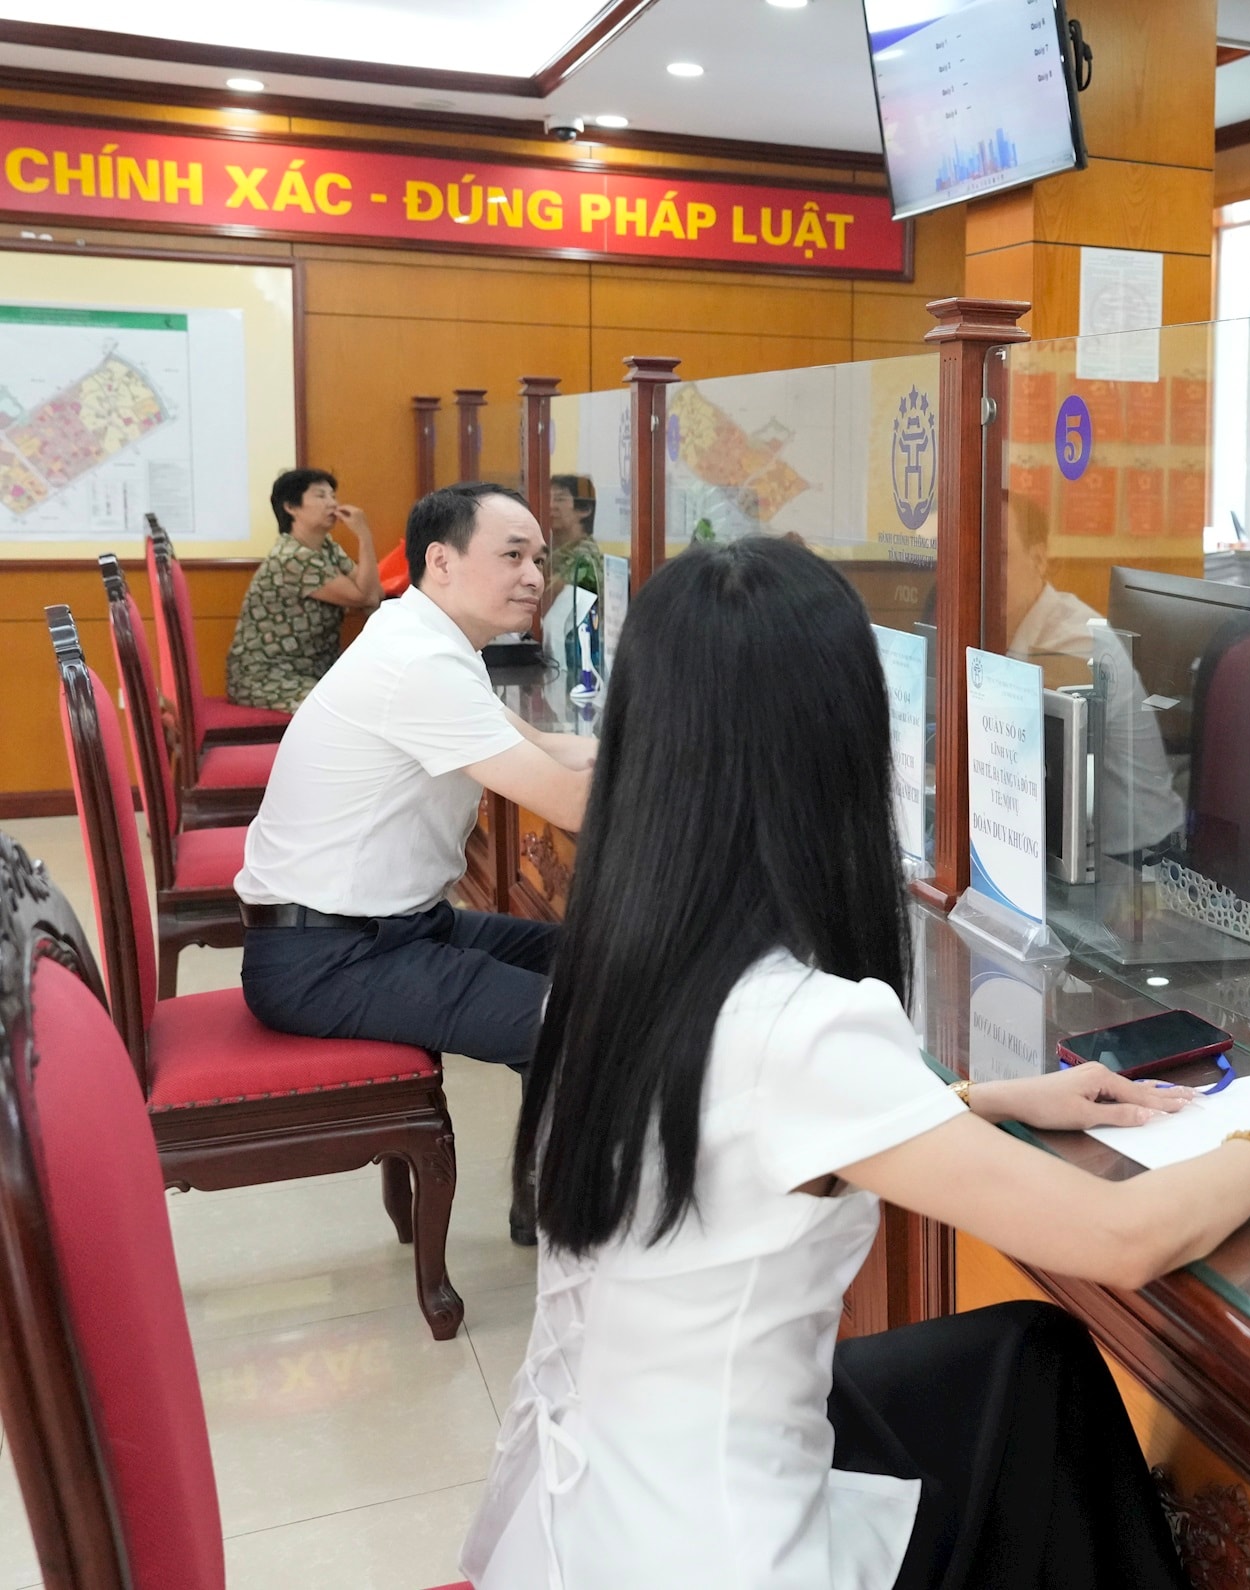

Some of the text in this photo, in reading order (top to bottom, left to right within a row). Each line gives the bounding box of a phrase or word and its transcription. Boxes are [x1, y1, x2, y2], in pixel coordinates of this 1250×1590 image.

[4, 143, 854, 258] CHÍNH XÁC - ĐÚNG PHÁP LUẬT
[1064, 414, 1083, 464] 5
[1005, 719, 1016, 739] SỐ
[1018, 727, 1026, 743] 05
[992, 820, 1008, 843] DUY
